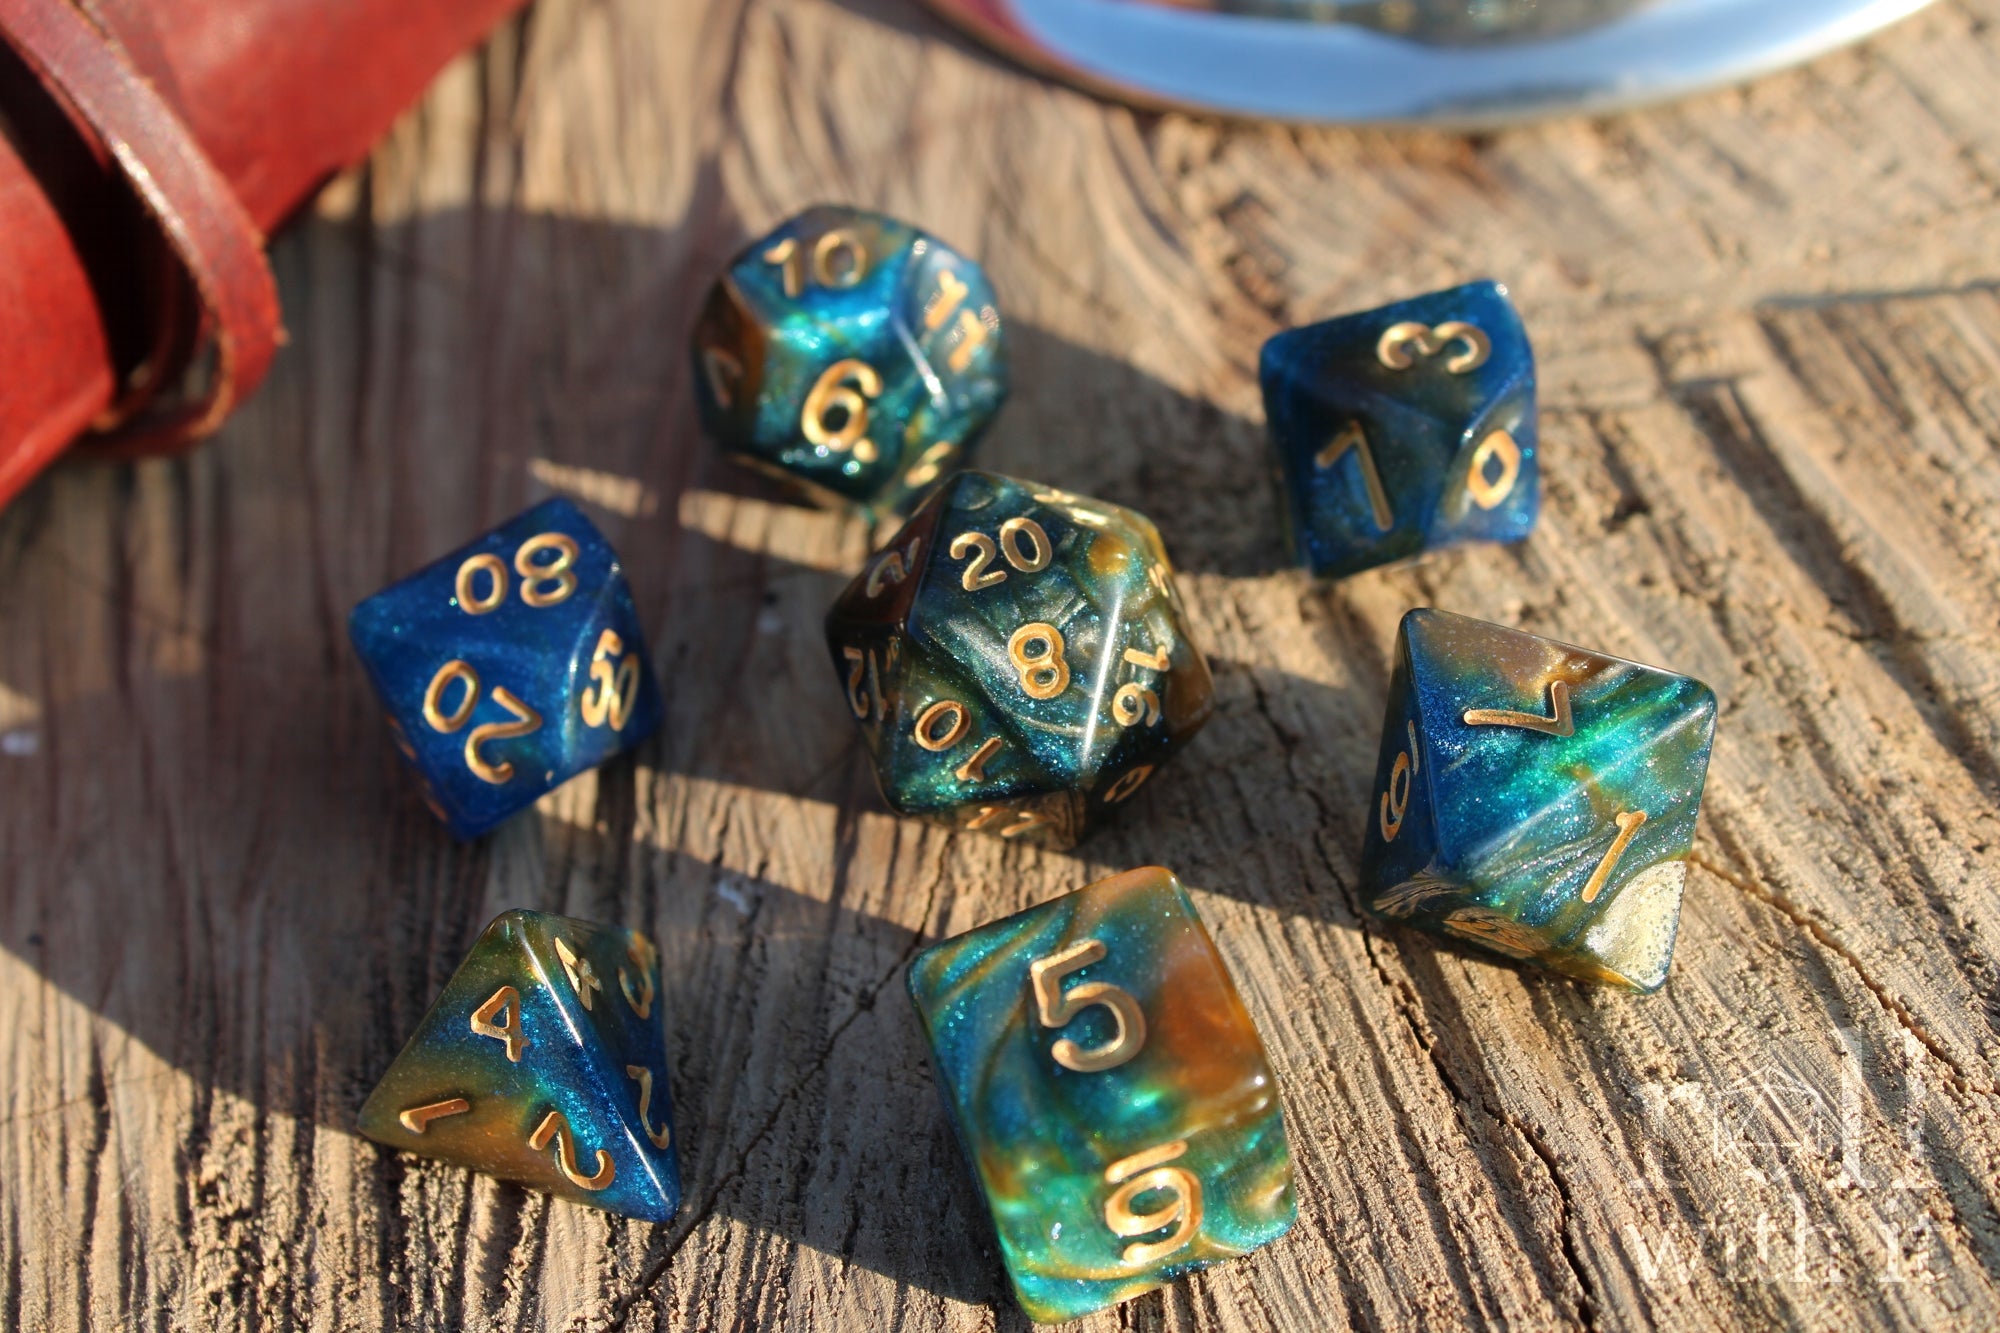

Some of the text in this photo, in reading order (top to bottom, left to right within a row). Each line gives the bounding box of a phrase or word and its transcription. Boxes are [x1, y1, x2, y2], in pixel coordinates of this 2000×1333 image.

[764, 229, 865, 298] 10
[1377, 321, 1491, 374] 3
[1466, 429, 1521, 511] 0
[456, 532, 578, 625] 80
[950, 517, 1053, 591] 20
[582, 629, 639, 731] 50
[1008, 622, 1071, 699] 8
[1582, 810, 1647, 903] 1
[470, 985, 530, 1062] 4
[1030, 939, 1147, 1073] 5
[400, 1098, 470, 1134] 1
[529, 1111, 615, 1190] 2
